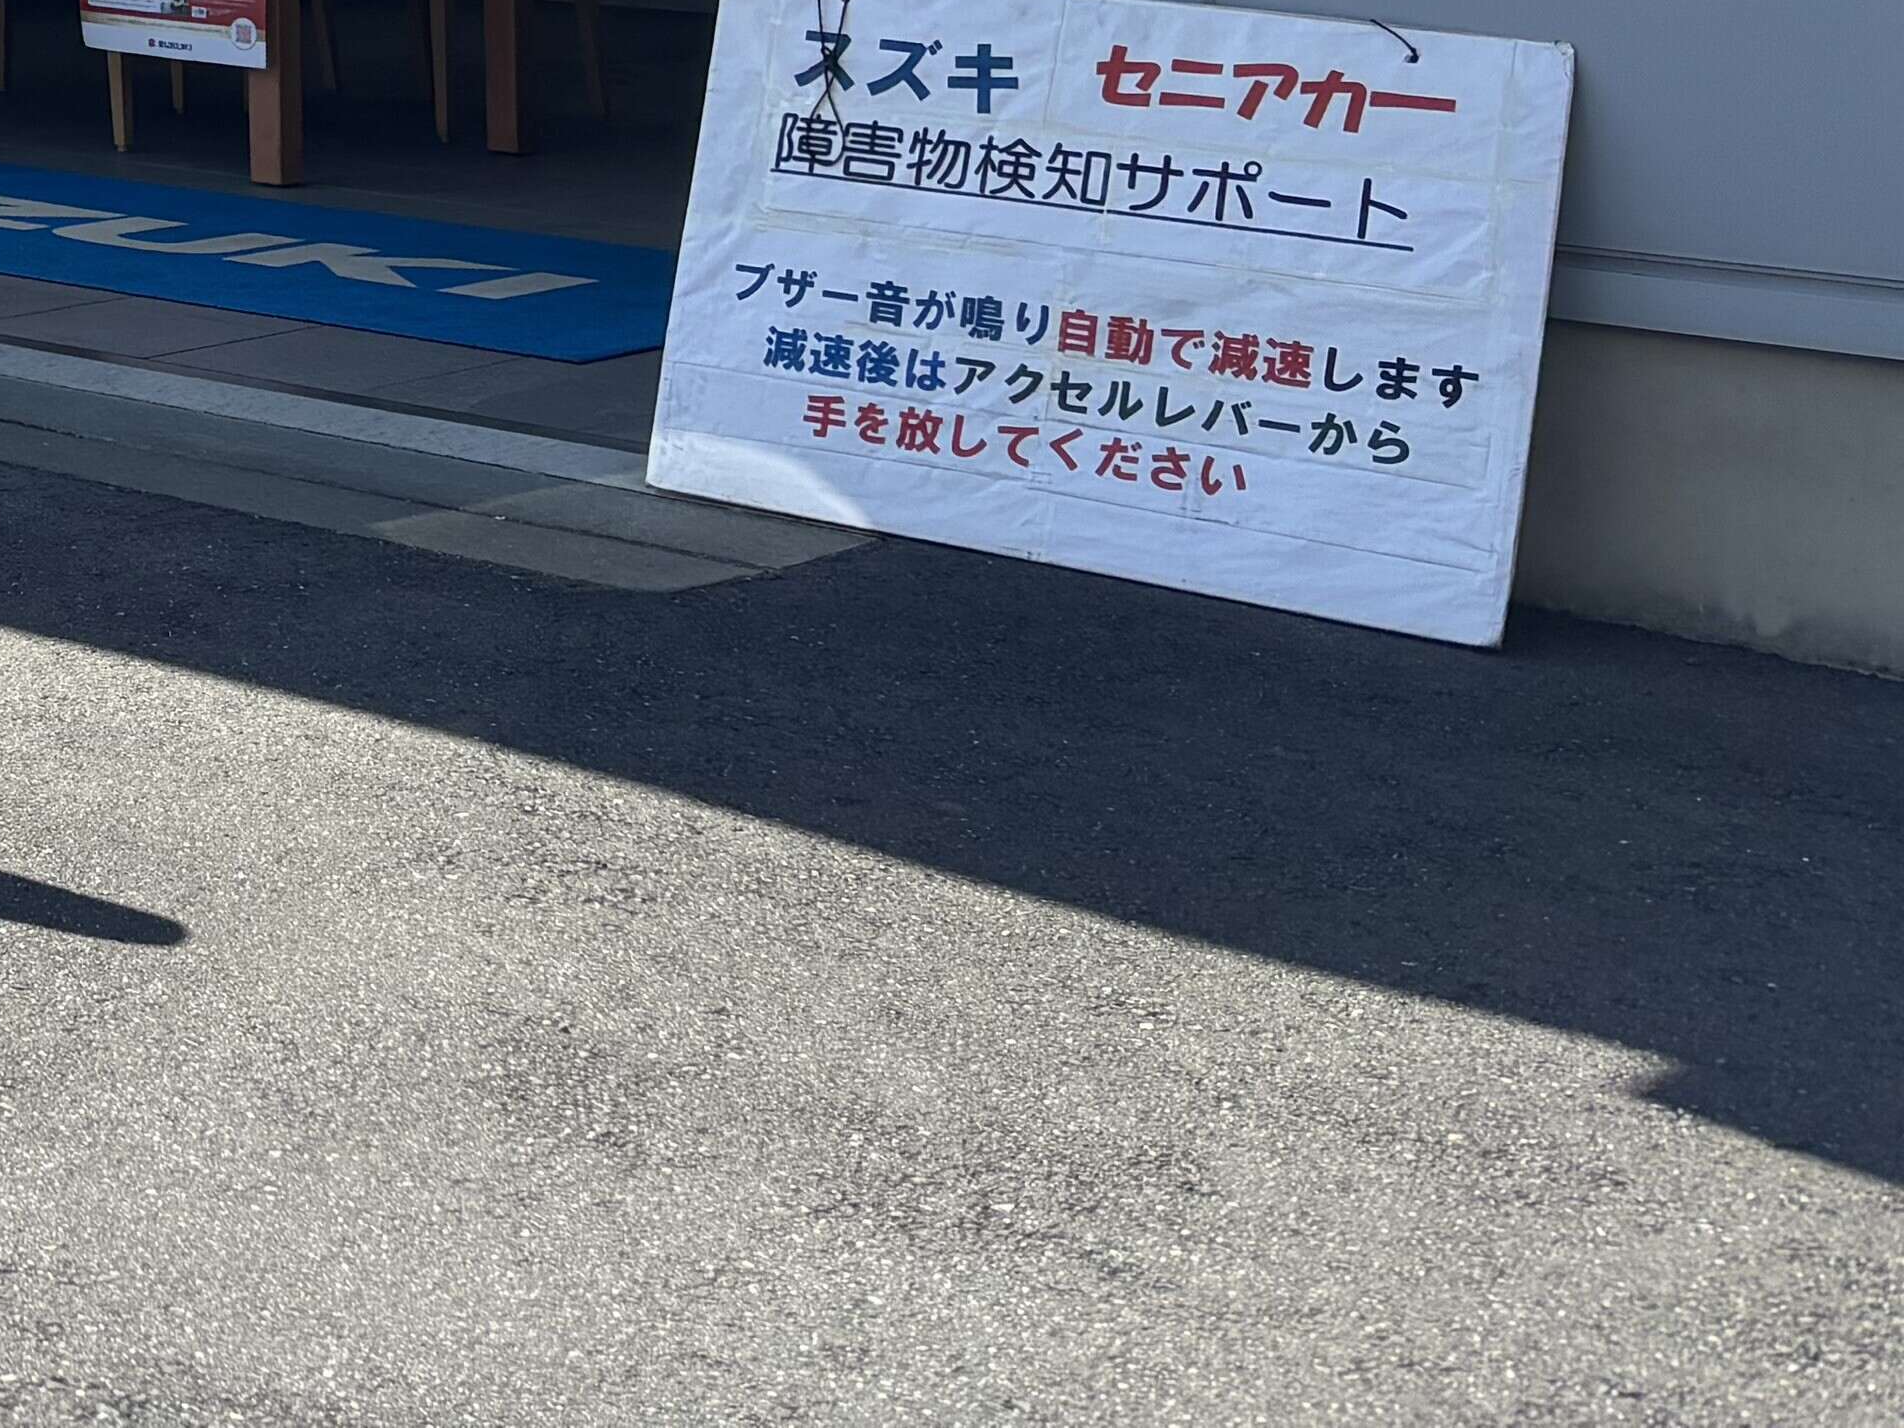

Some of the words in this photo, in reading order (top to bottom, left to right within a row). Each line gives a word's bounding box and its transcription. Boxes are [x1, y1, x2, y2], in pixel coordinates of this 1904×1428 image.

[794, 29, 1020, 115] スズキ
[1096, 43, 1457, 134] セニアカー
[774, 111, 1410, 240] 障害物検知サポート
[733, 262, 1481, 410] ブザー音が鳴り自動で減速します
[762, 324, 1412, 466] 減速後はアクセルレバーから
[802, 393, 1249, 497] 手を放してください
